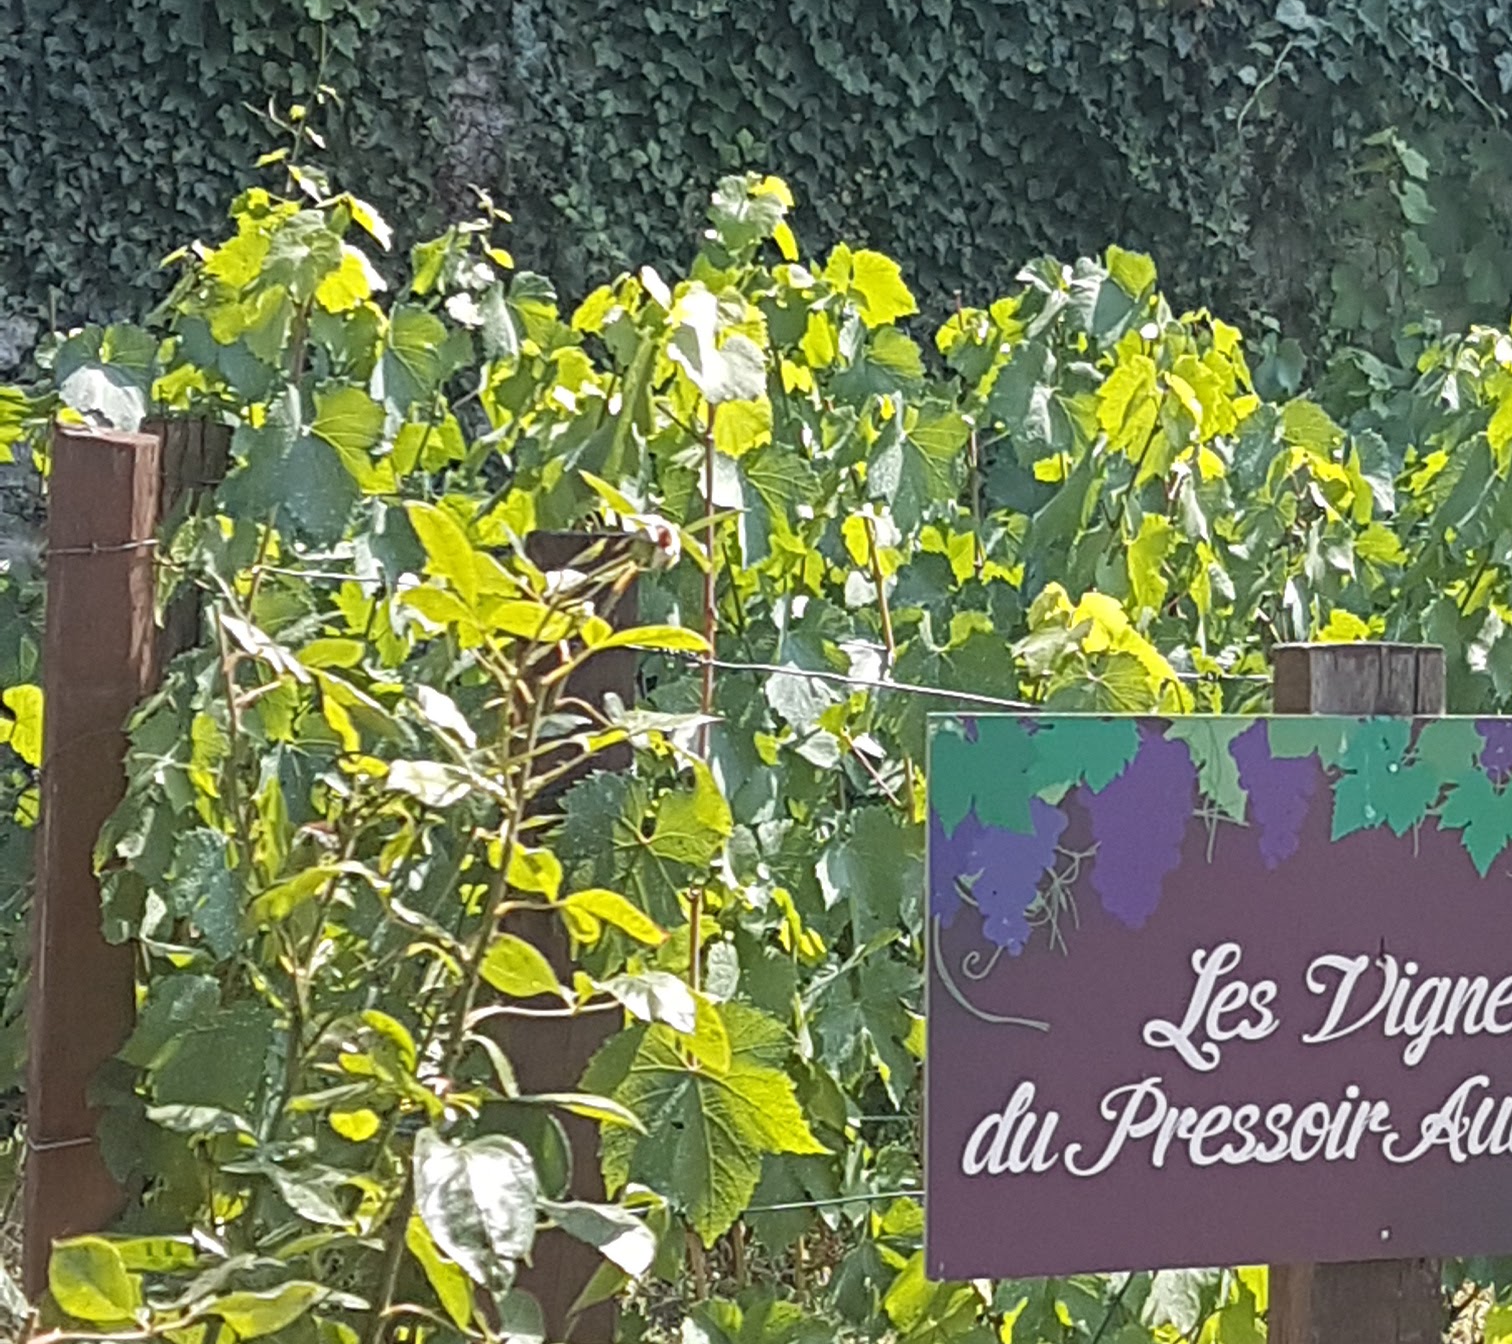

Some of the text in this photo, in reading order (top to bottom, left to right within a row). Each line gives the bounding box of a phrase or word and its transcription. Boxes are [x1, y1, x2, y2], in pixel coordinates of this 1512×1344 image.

[1143, 942, 1280, 1071] Les
[962, 1080, 1059, 1175] du
[1064, 1076, 1392, 1175] Pressoir
